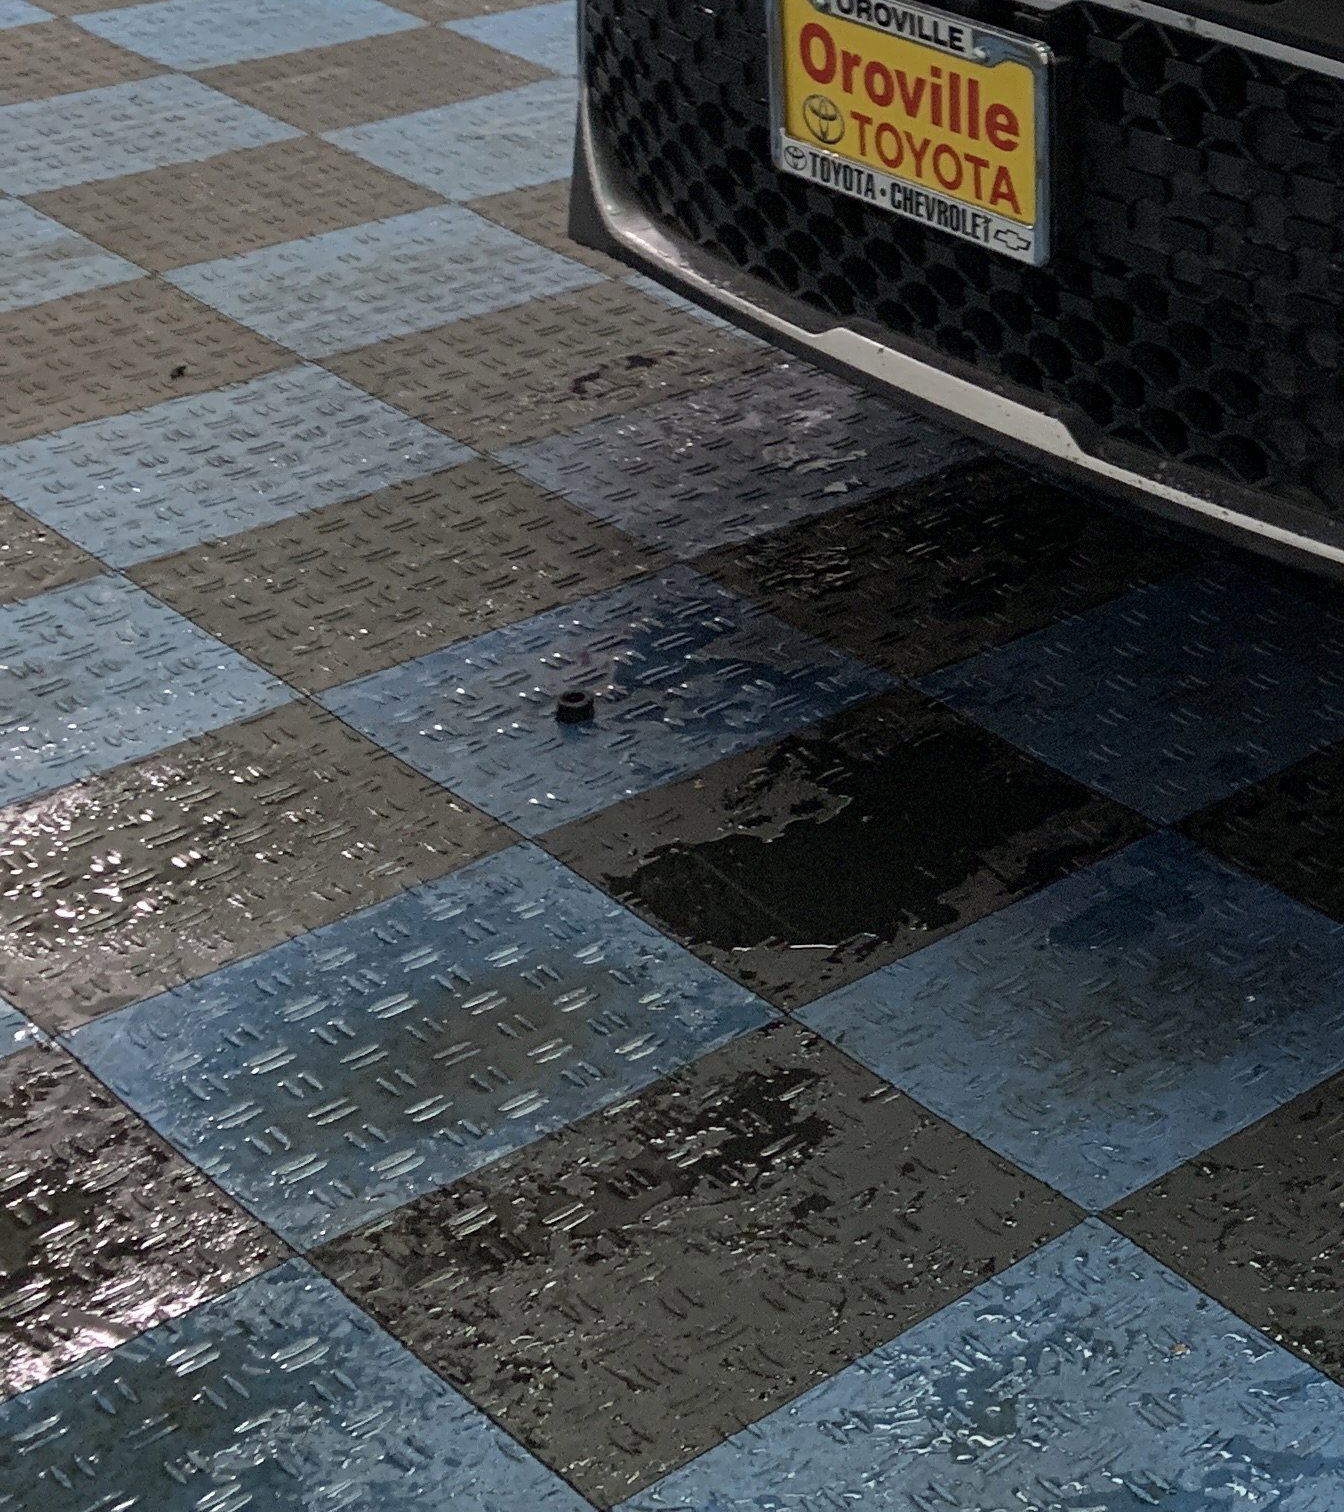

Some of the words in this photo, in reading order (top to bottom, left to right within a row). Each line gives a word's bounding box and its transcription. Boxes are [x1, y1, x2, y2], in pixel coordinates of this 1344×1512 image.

[799, 21, 1021, 153] Oroville
[808, 150, 877, 202] TOYOTA
[889, 181, 993, 244] CHEVROLET
[849, 109, 1023, 216] TOYOTA
